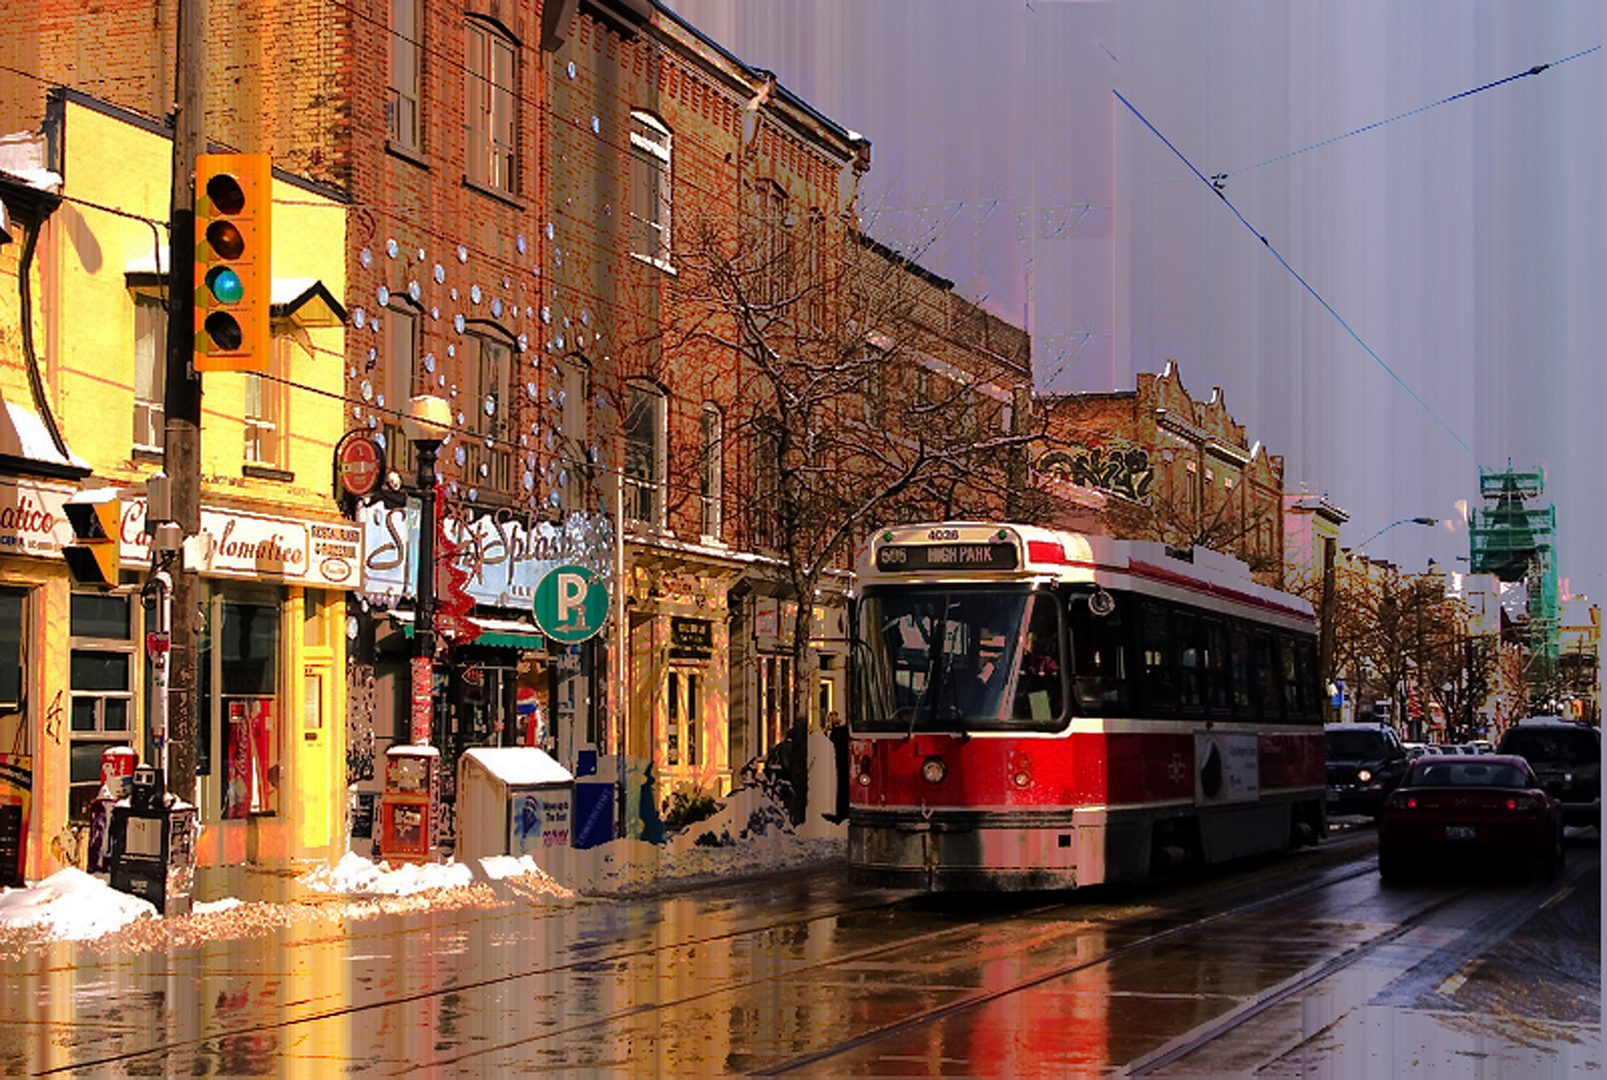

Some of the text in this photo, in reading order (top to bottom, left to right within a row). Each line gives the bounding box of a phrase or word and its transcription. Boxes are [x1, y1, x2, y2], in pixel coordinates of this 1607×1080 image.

[0, 496, 54, 534] atico
[927, 529, 960, 541] 4026
[927, 547, 957, 563] HIGH
[959, 546, 992, 562] PARK
[557, 573, 588, 621] P
